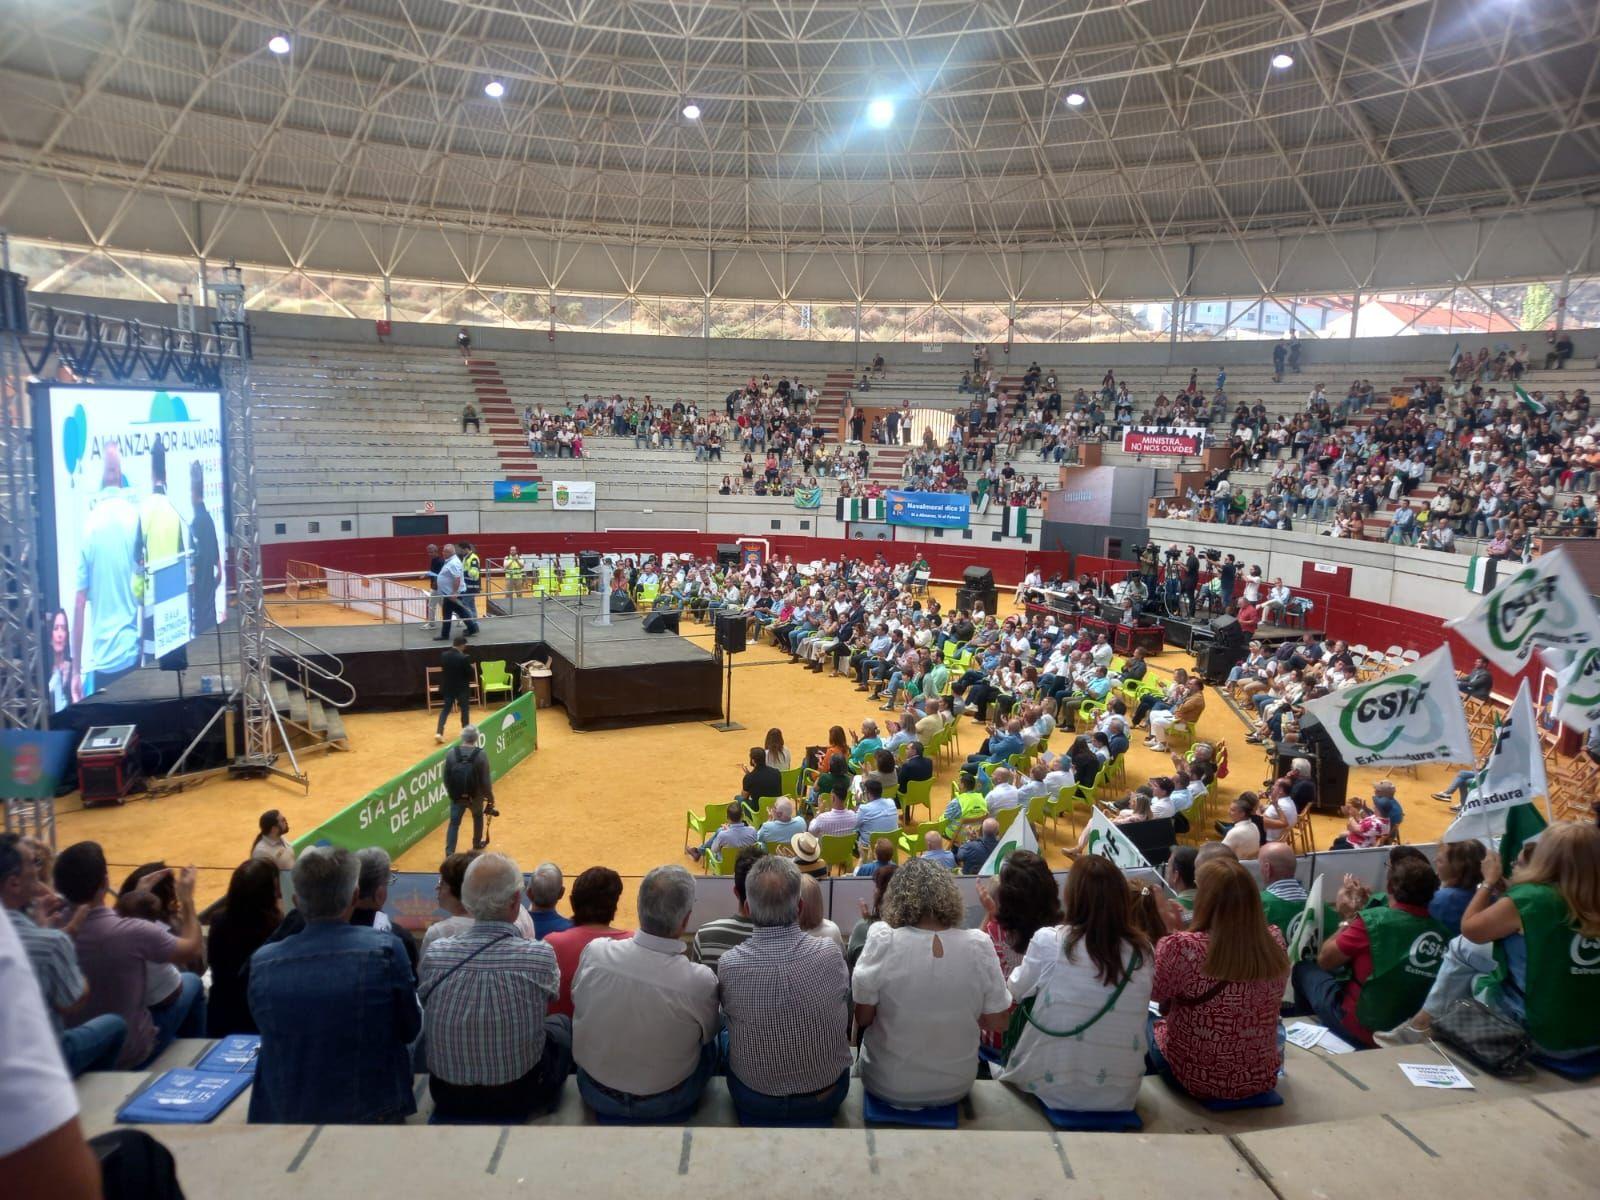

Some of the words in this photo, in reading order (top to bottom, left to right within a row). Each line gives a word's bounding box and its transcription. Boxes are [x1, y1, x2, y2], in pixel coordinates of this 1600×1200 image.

[182, 428, 222, 450] ALMARA
[1131, 442, 1142, 452] NO
[1143, 444, 1160, 452] NOS
[1161, 444, 1193, 454] OLVIDES
[907, 502, 943, 511] Navalmoral
[359, 800, 373, 829] SÍ
[375, 800, 385, 819] A
[388, 785, 408, 810] LA
[390, 806, 410, 834] DE
[413, 782, 449, 819] ALMA
